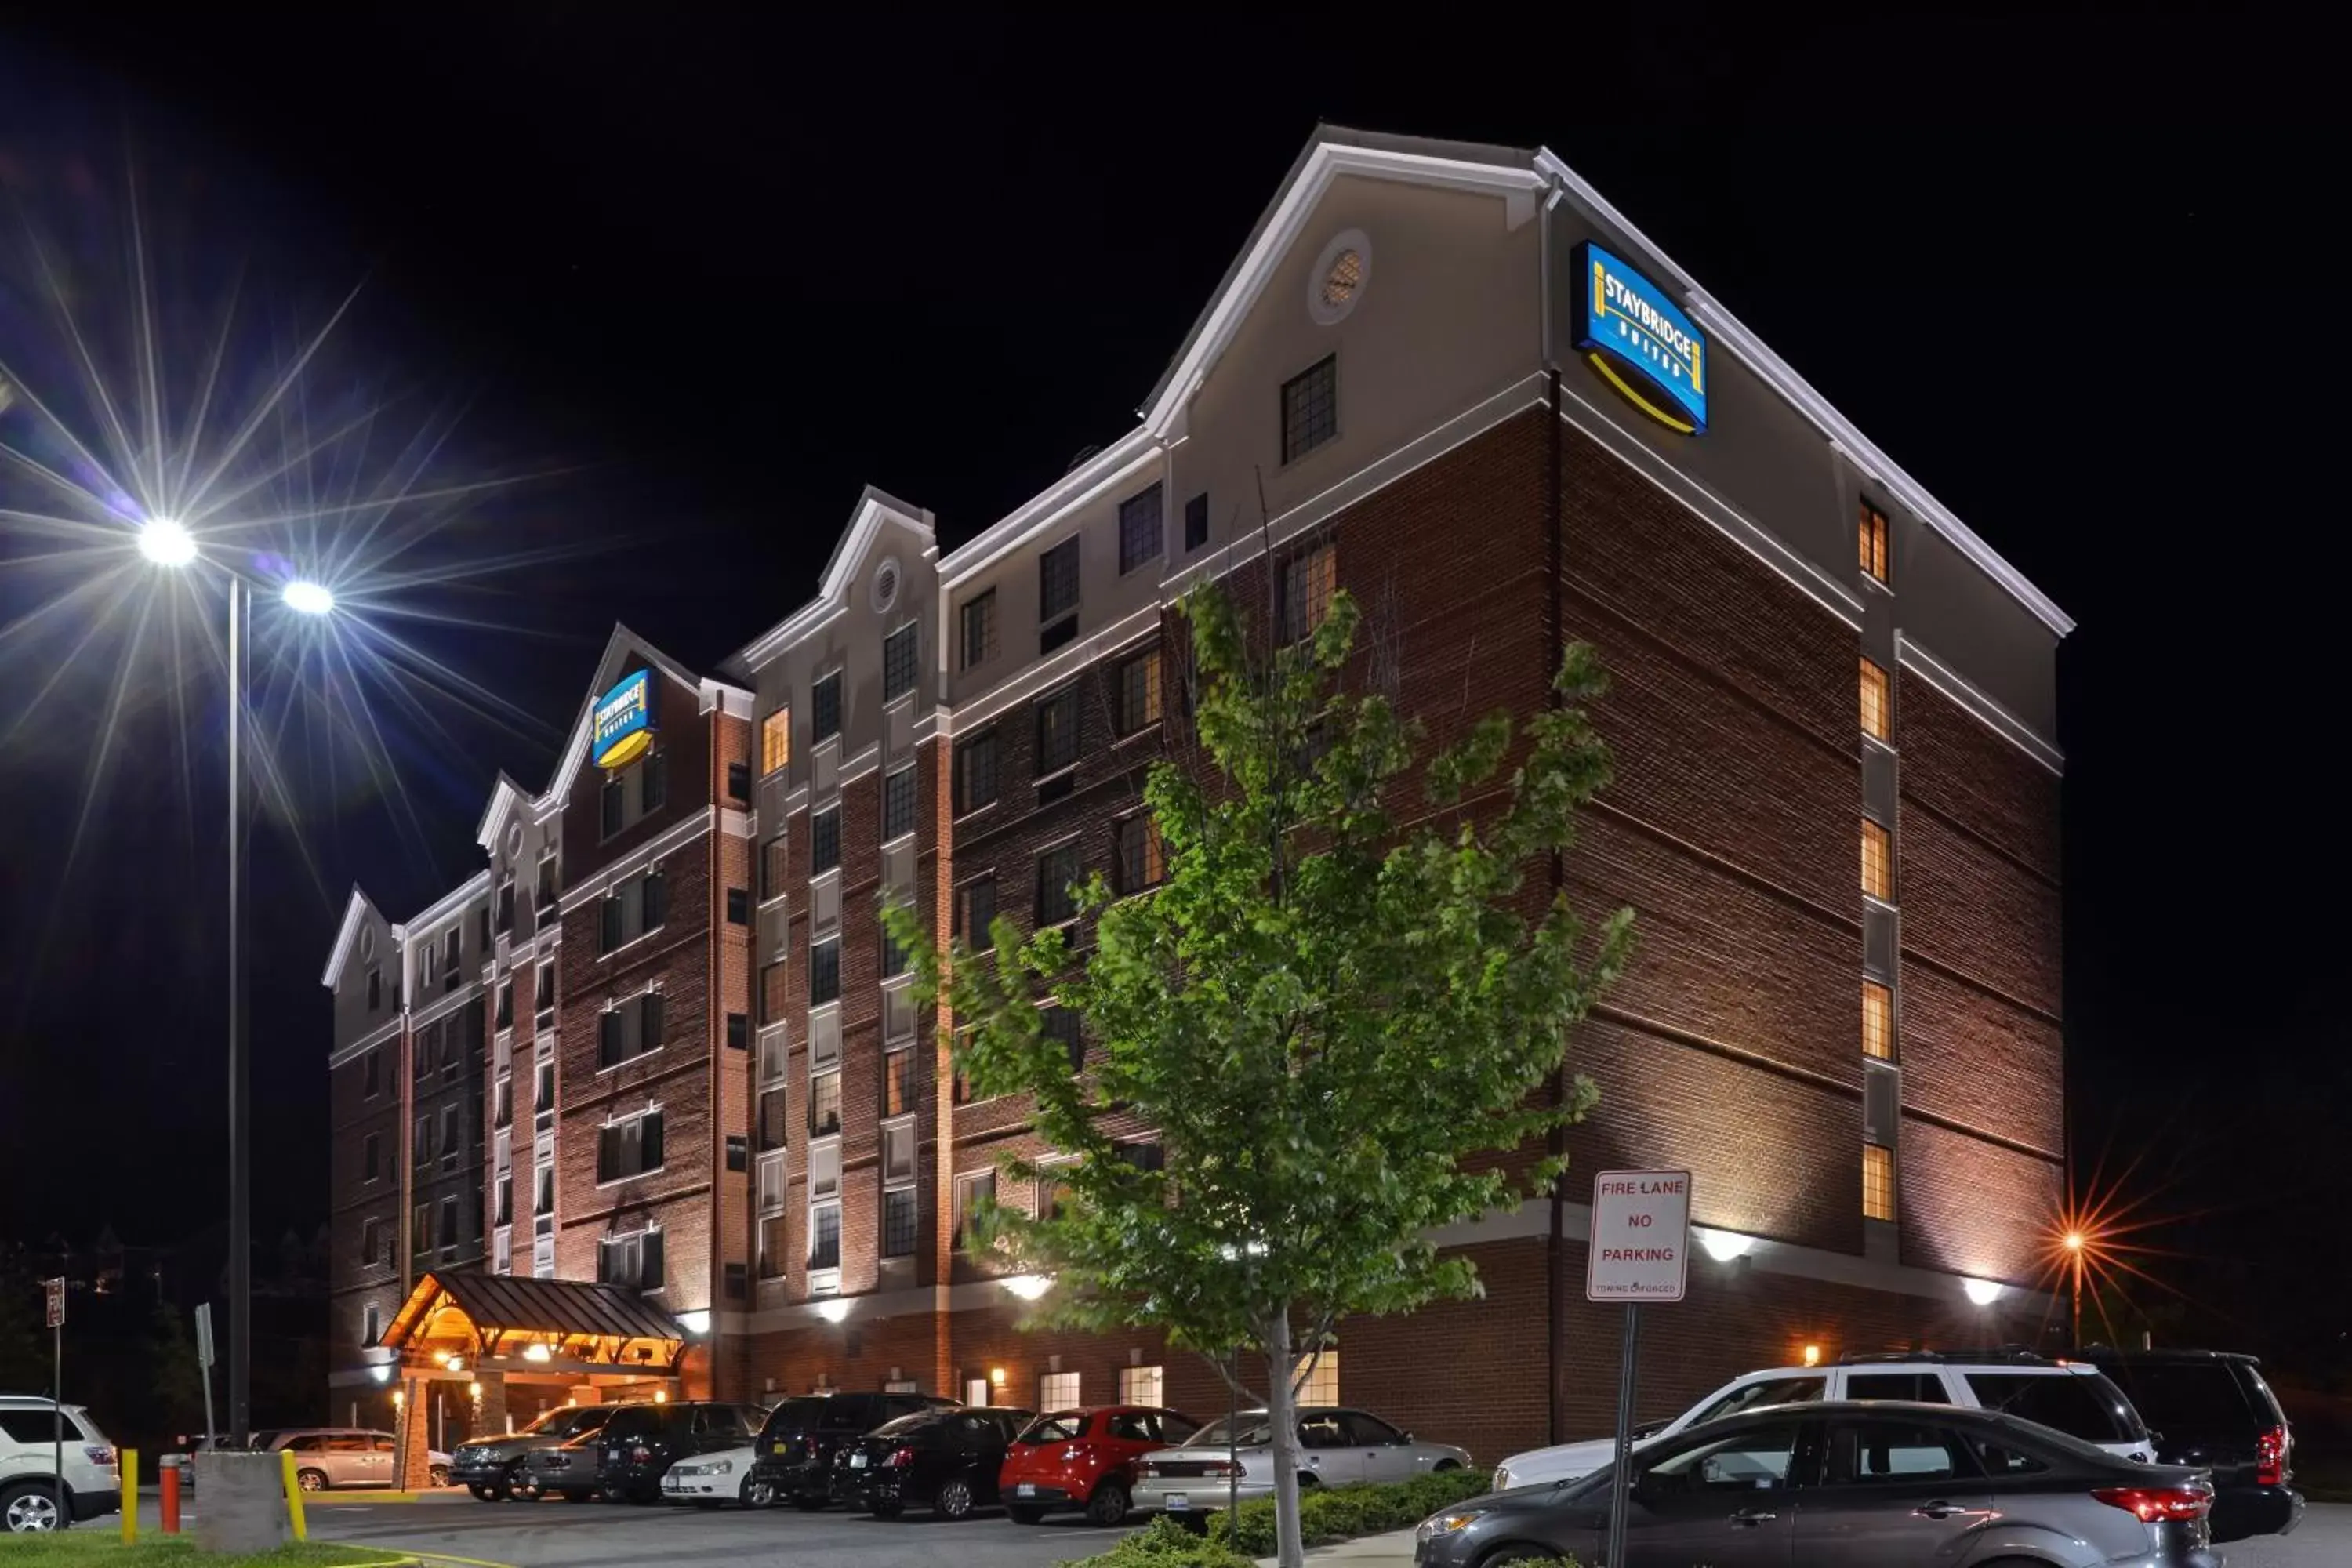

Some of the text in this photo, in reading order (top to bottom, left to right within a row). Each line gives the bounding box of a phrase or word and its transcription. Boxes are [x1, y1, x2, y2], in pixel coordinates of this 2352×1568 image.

[1606, 274, 1691, 360] STAYBRIDGE
[1602, 1181, 1684, 1196] FIRE LANE
[1628, 1214, 1652, 1228] NO
[1602, 1248, 1675, 1261] PARKING
